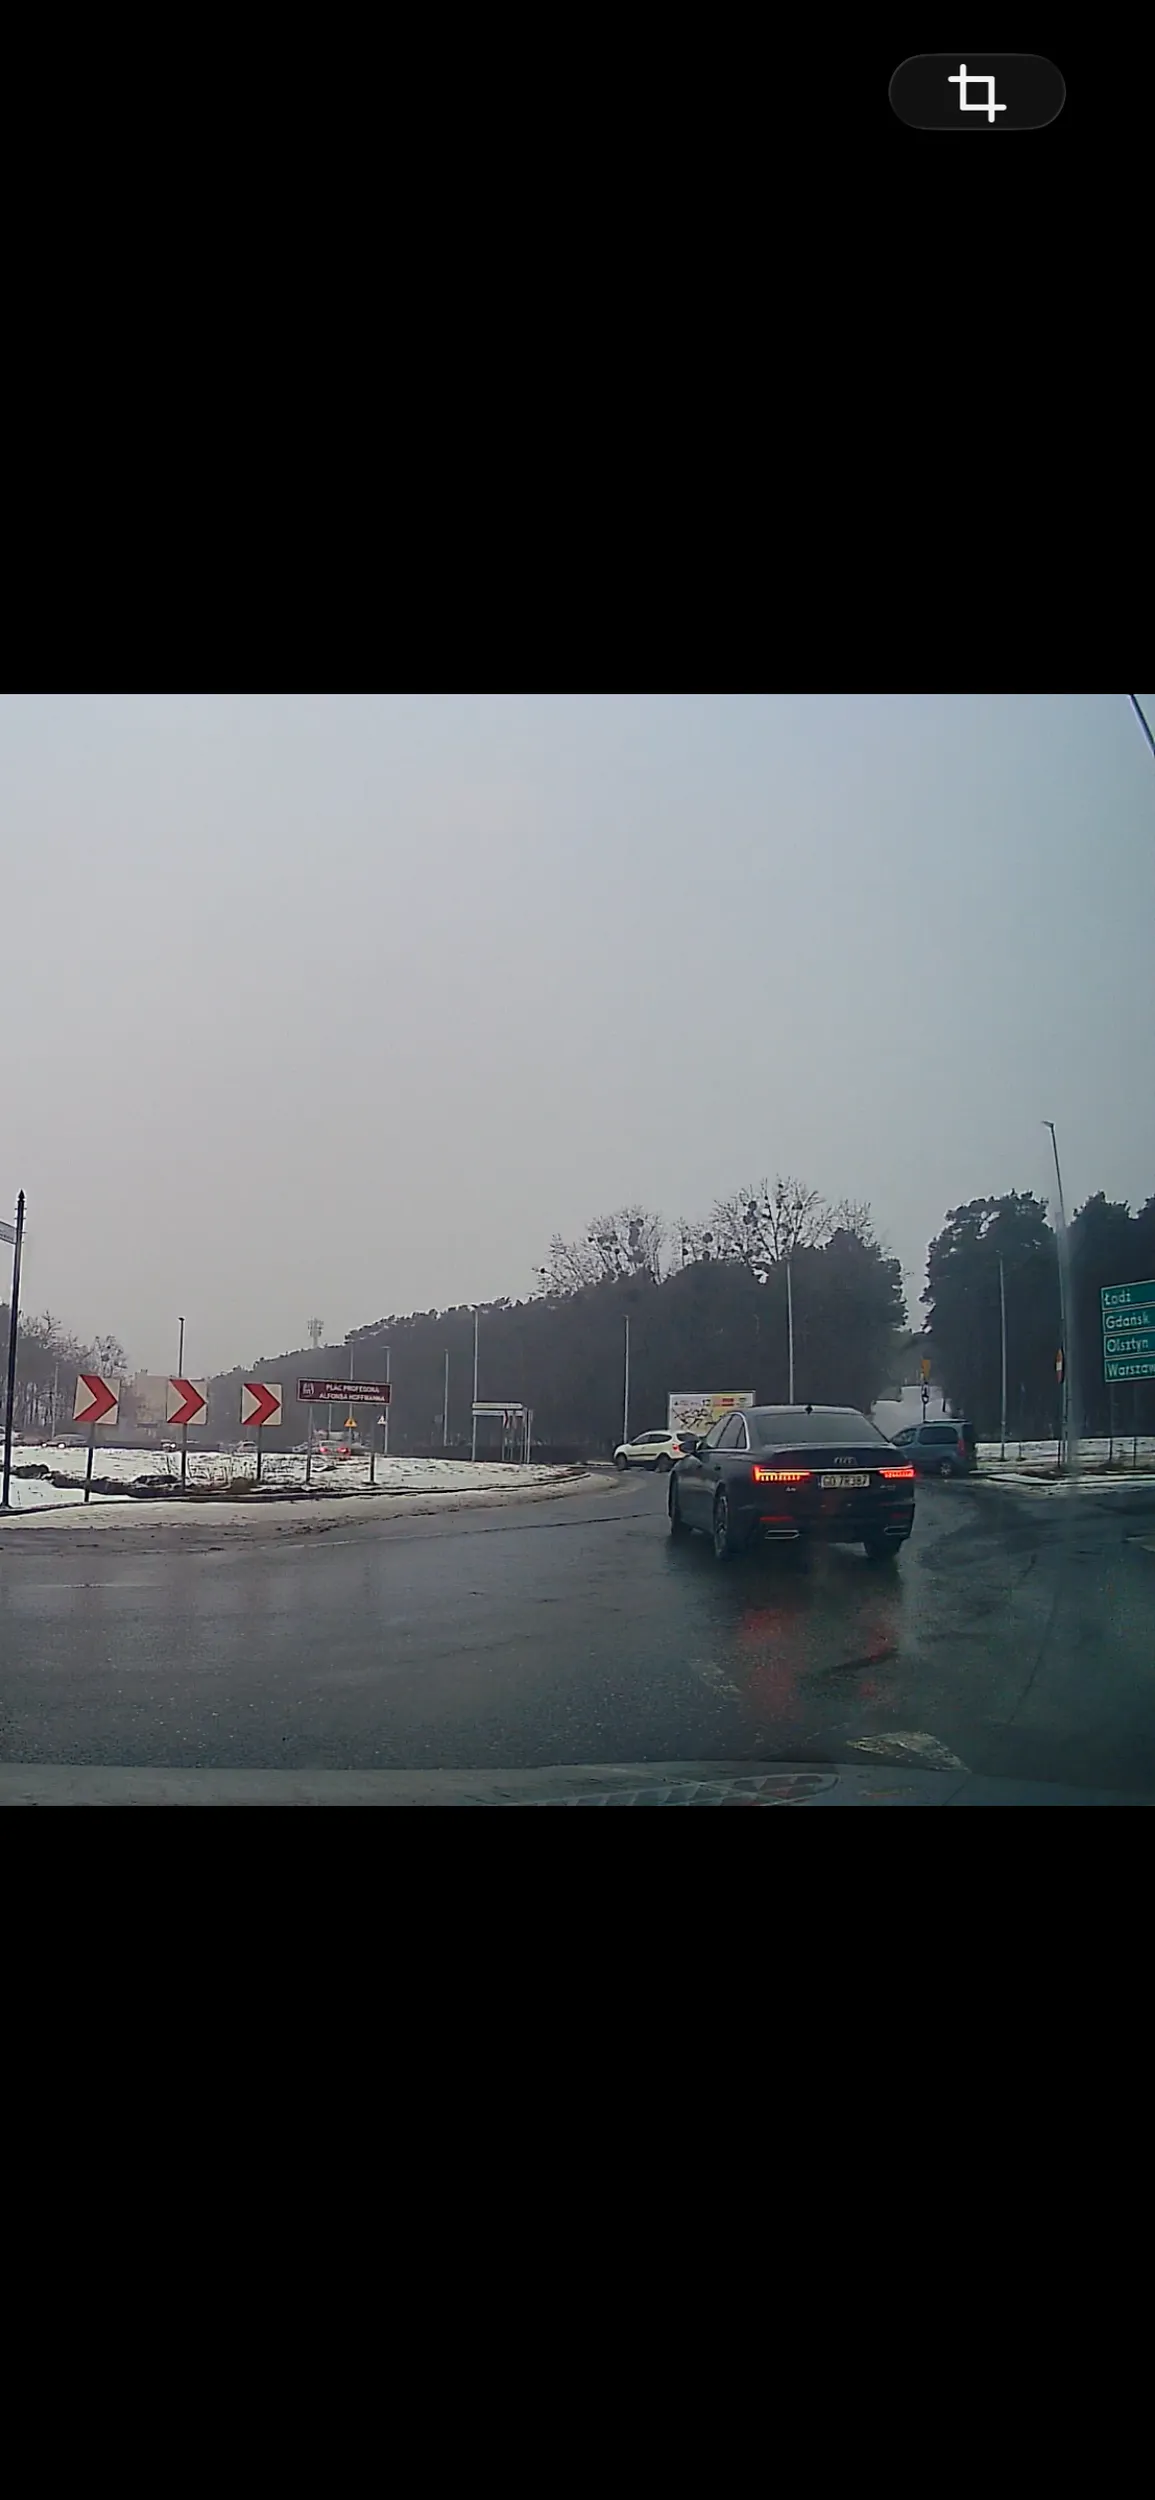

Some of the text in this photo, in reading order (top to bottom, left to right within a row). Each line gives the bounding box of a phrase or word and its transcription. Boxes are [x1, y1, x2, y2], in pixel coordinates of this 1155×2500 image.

[1105, 1311, 1150, 1328] Gdańsk
[1106, 1338, 1149, 1353] Olsztyn
[343, 1385, 379, 1393] PROFESORA
[319, 1392, 348, 1400] ALFONSA
